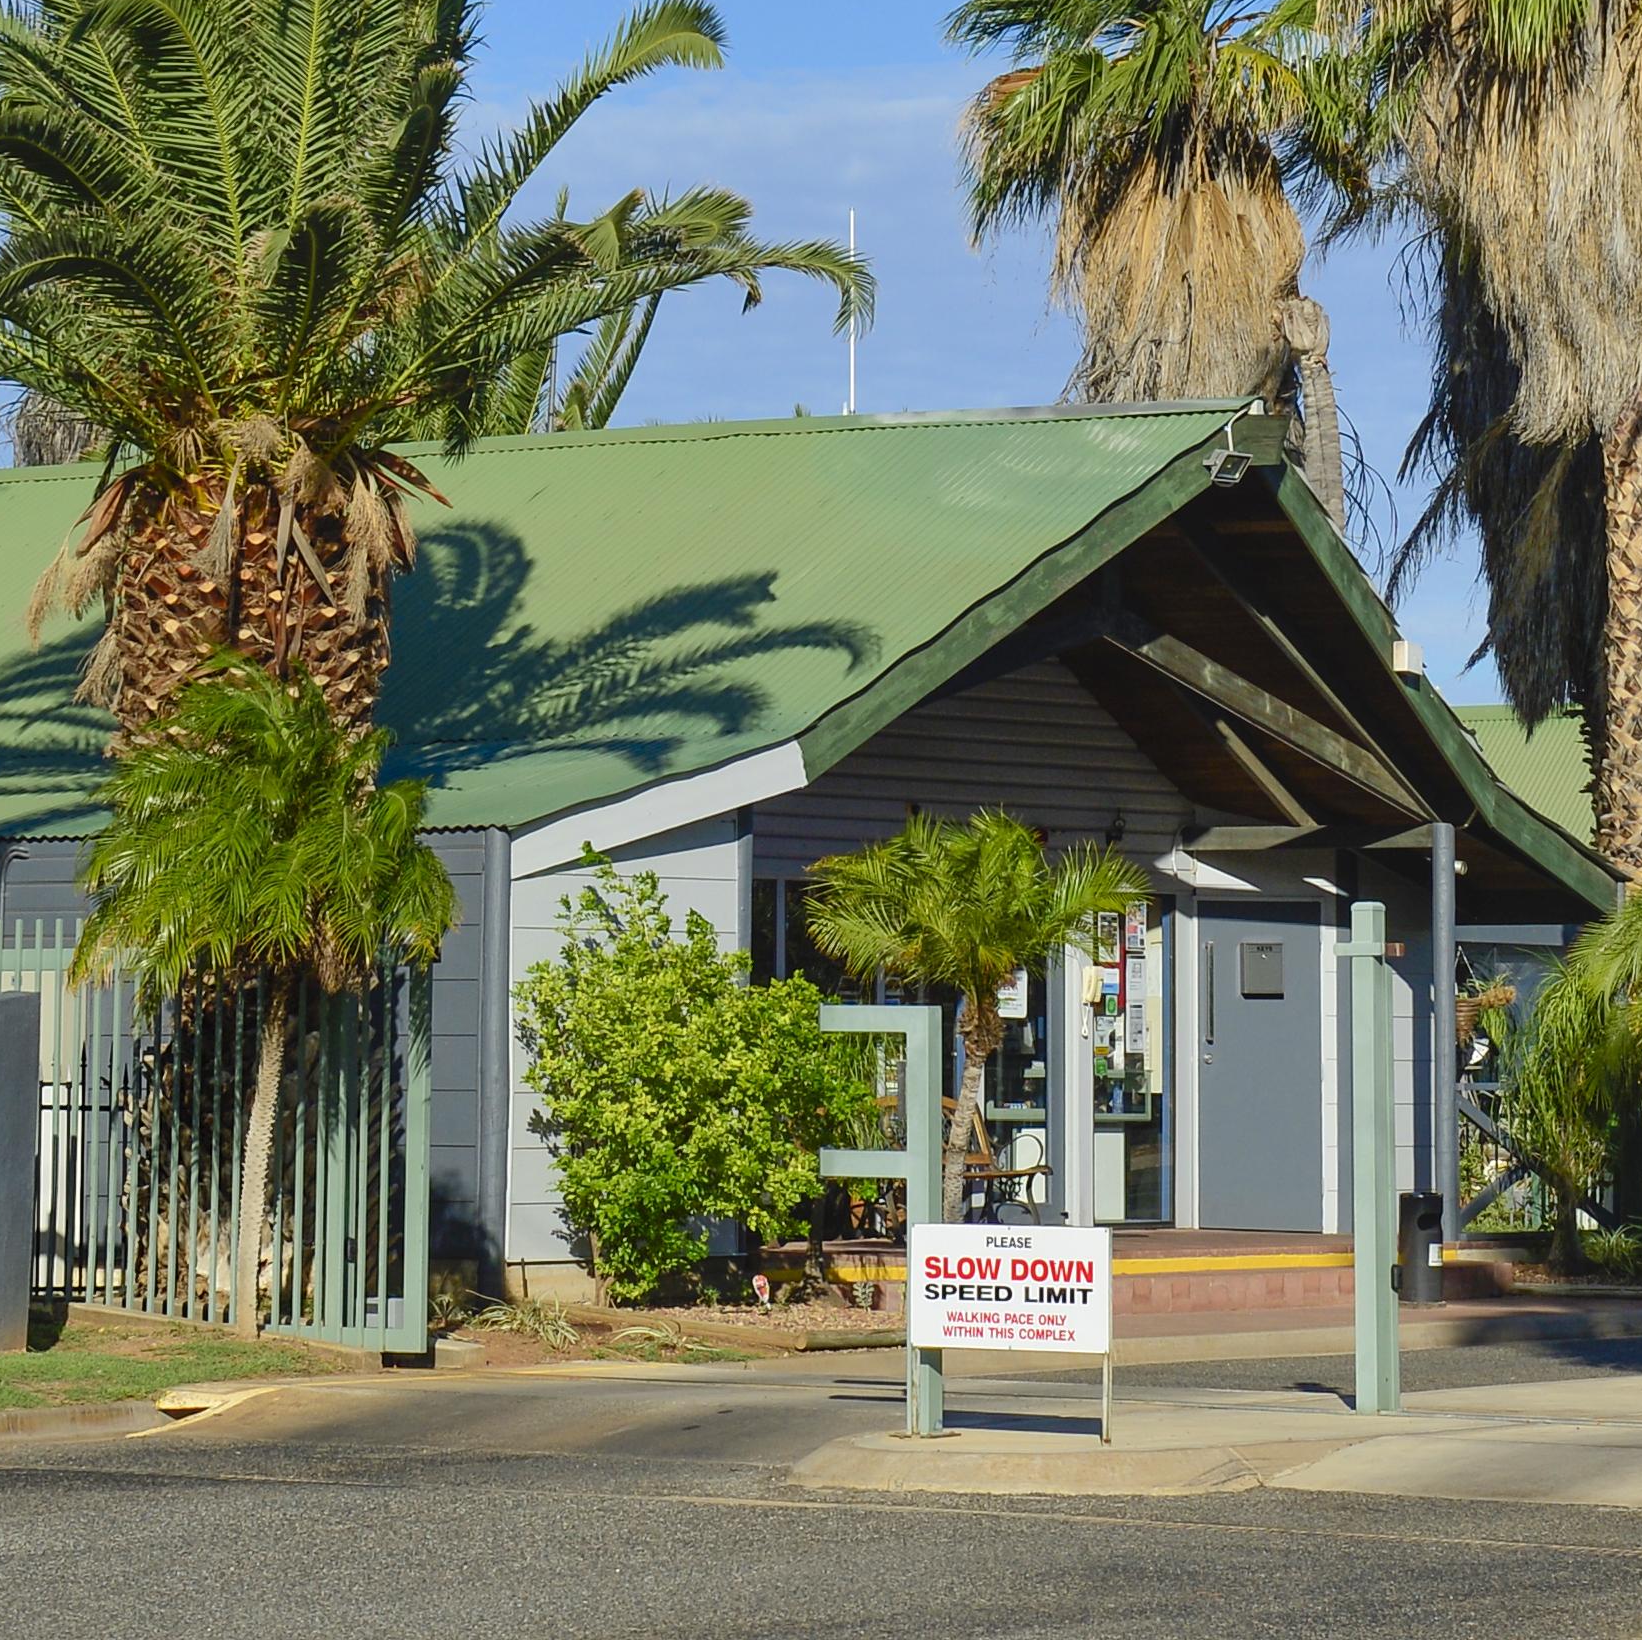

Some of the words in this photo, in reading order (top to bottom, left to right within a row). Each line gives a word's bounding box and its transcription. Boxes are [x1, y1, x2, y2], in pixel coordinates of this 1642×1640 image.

[986, 1236, 1032, 1249] PLEASE
[924, 1256, 1001, 1280] SLOW
[1011, 1259, 1094, 1283] DOWN
[924, 1284, 1013, 1302] SPEED
[1024, 1286, 1093, 1304] LIMIT
[947, 1311, 1000, 1324] WALKING
[1004, 1312, 1034, 1325] PACE
[1038, 1314, 1067, 1326] ONLY
[943, 1326, 984, 1339] WITHIN
[990, 1327, 1014, 1339] THIS
[1019, 1328, 1076, 1341] COMPLEX
